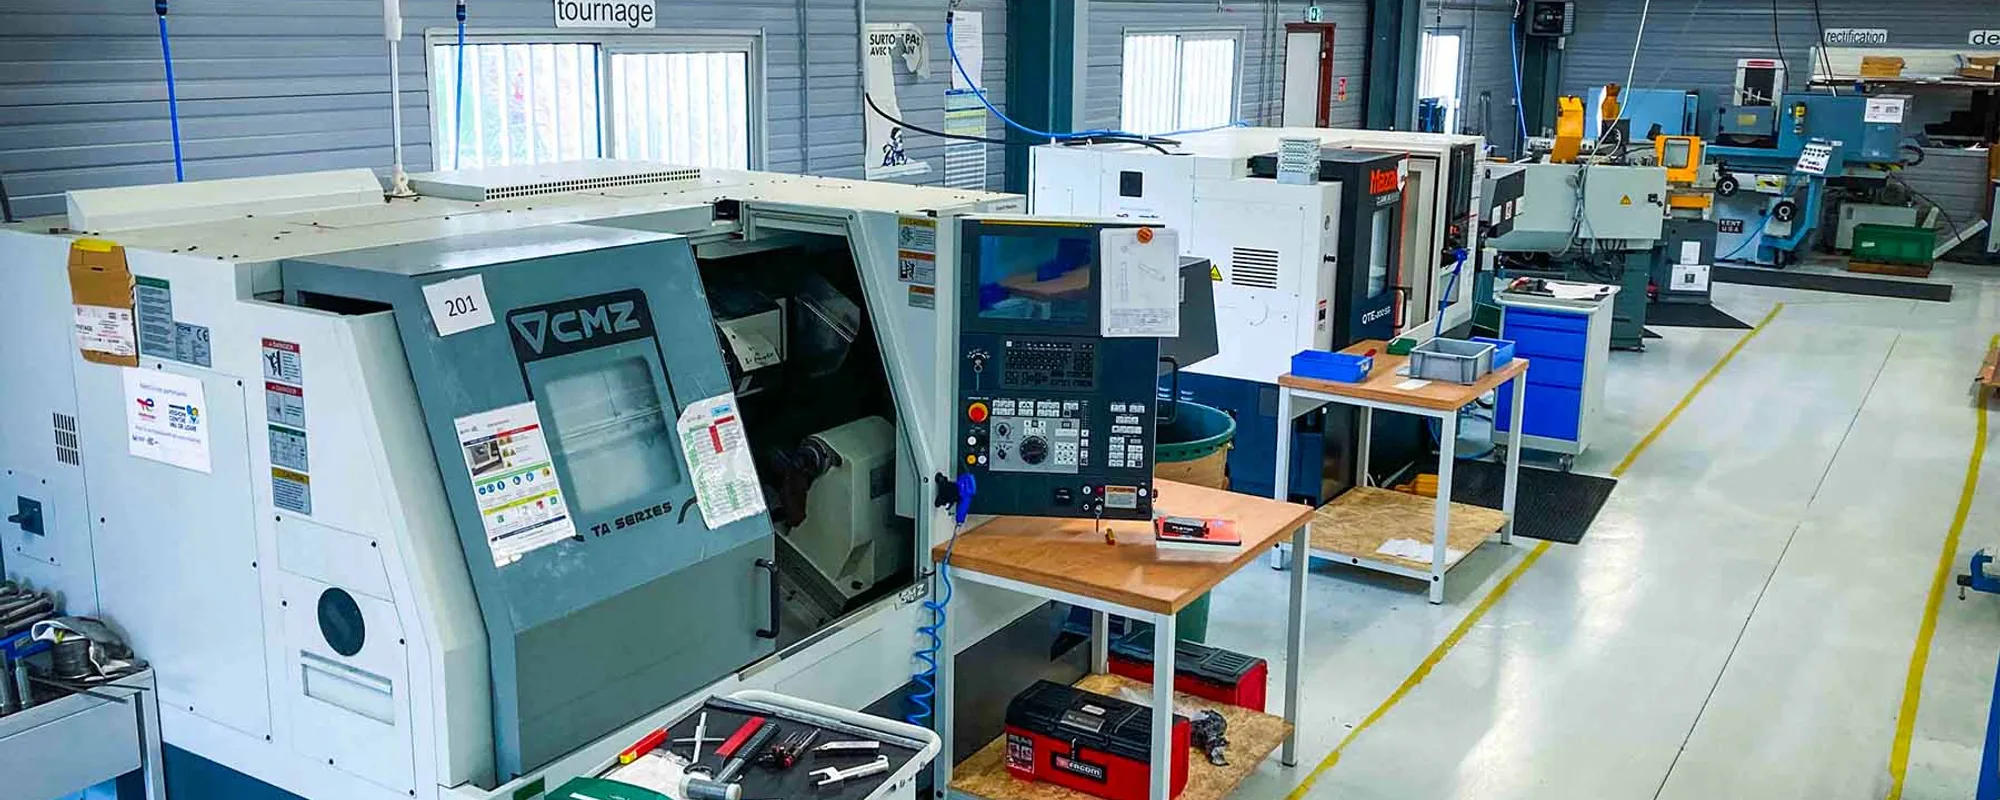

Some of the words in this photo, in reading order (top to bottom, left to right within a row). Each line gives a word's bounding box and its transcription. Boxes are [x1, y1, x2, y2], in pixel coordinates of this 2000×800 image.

[557, 0, 653, 28] tournage
[1826, 30, 1886, 43] rectification
[869, 46, 887, 56] AVEC
[1369, 167, 1398, 195] Maza
[444, 295, 478, 317] 201
[551, 300, 642, 343] CMZ
[590, 523, 611, 538] TA
[614, 501, 673, 530] SERIES
